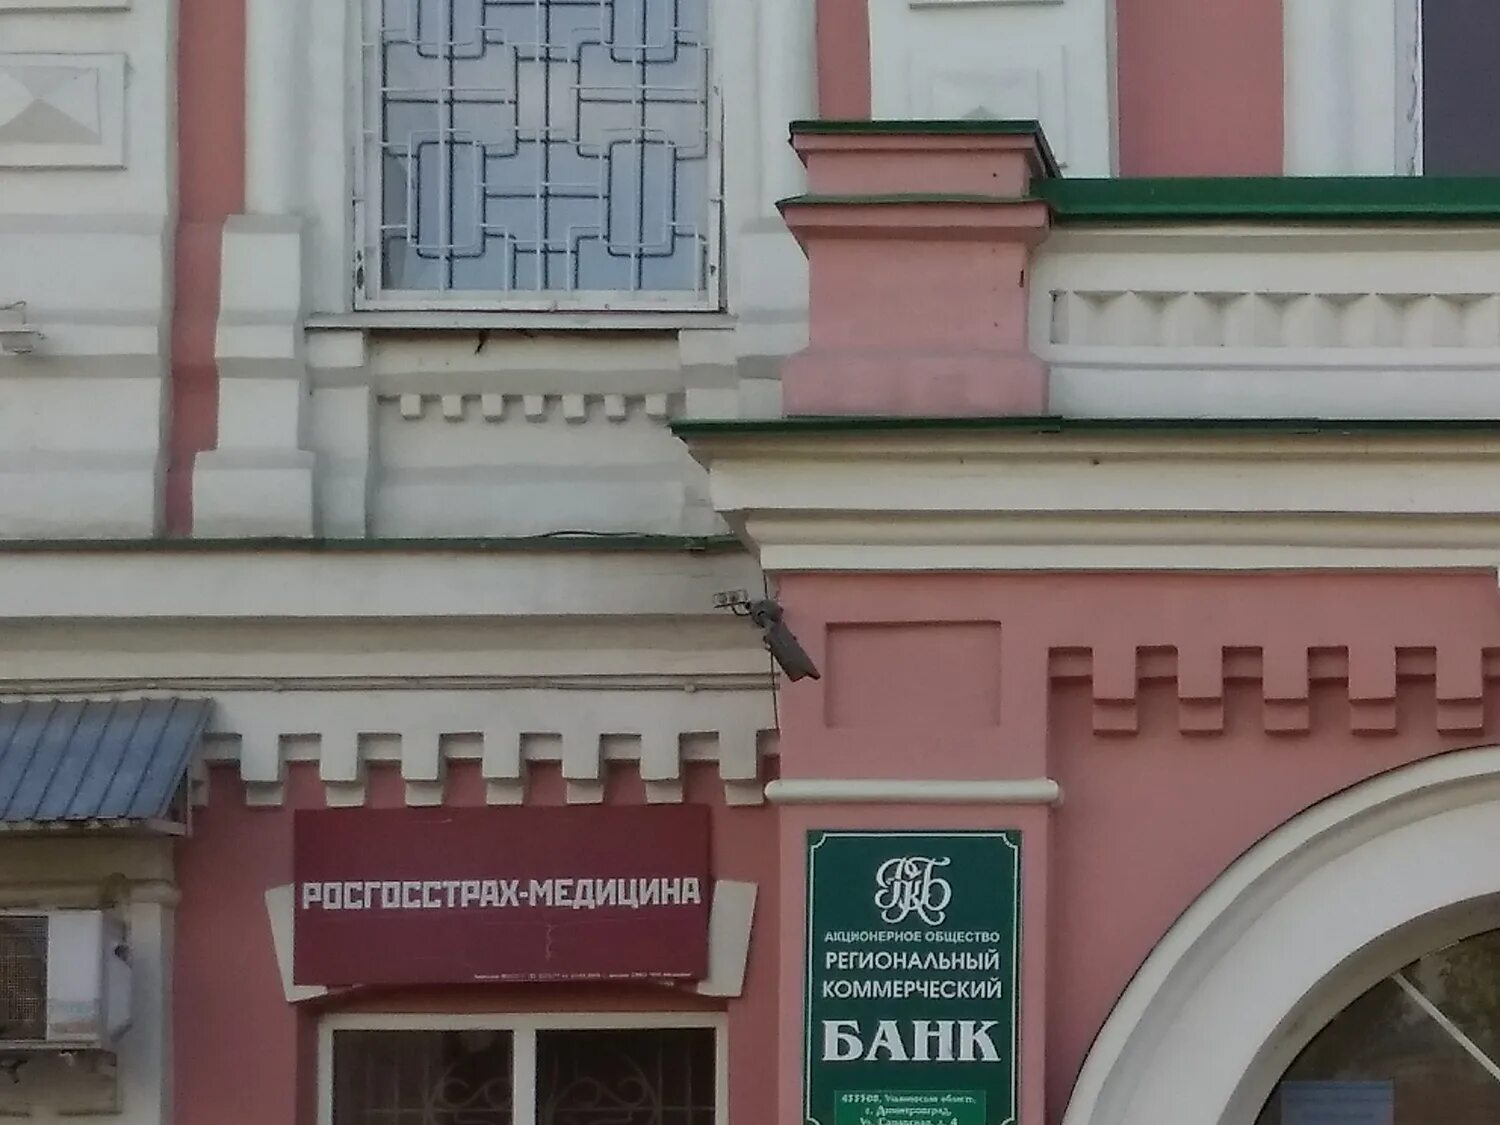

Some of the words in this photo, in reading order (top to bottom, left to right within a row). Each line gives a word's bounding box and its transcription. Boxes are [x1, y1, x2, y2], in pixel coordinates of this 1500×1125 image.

[303, 877, 701, 910] РОСГОССТРАХ-МЕДИЦИНА
[824, 930, 922, 944] АКЦИОНЕРНОЕ
[925, 930, 1000, 944] ОБЩЕСТВО
[825, 948, 1000, 970] РЕГИОНАЛЬНЫЙ
[822, 976, 1002, 1000] КОММЕРЧЕСКИЙ
[821, 1019, 1001, 1062] БАНК
